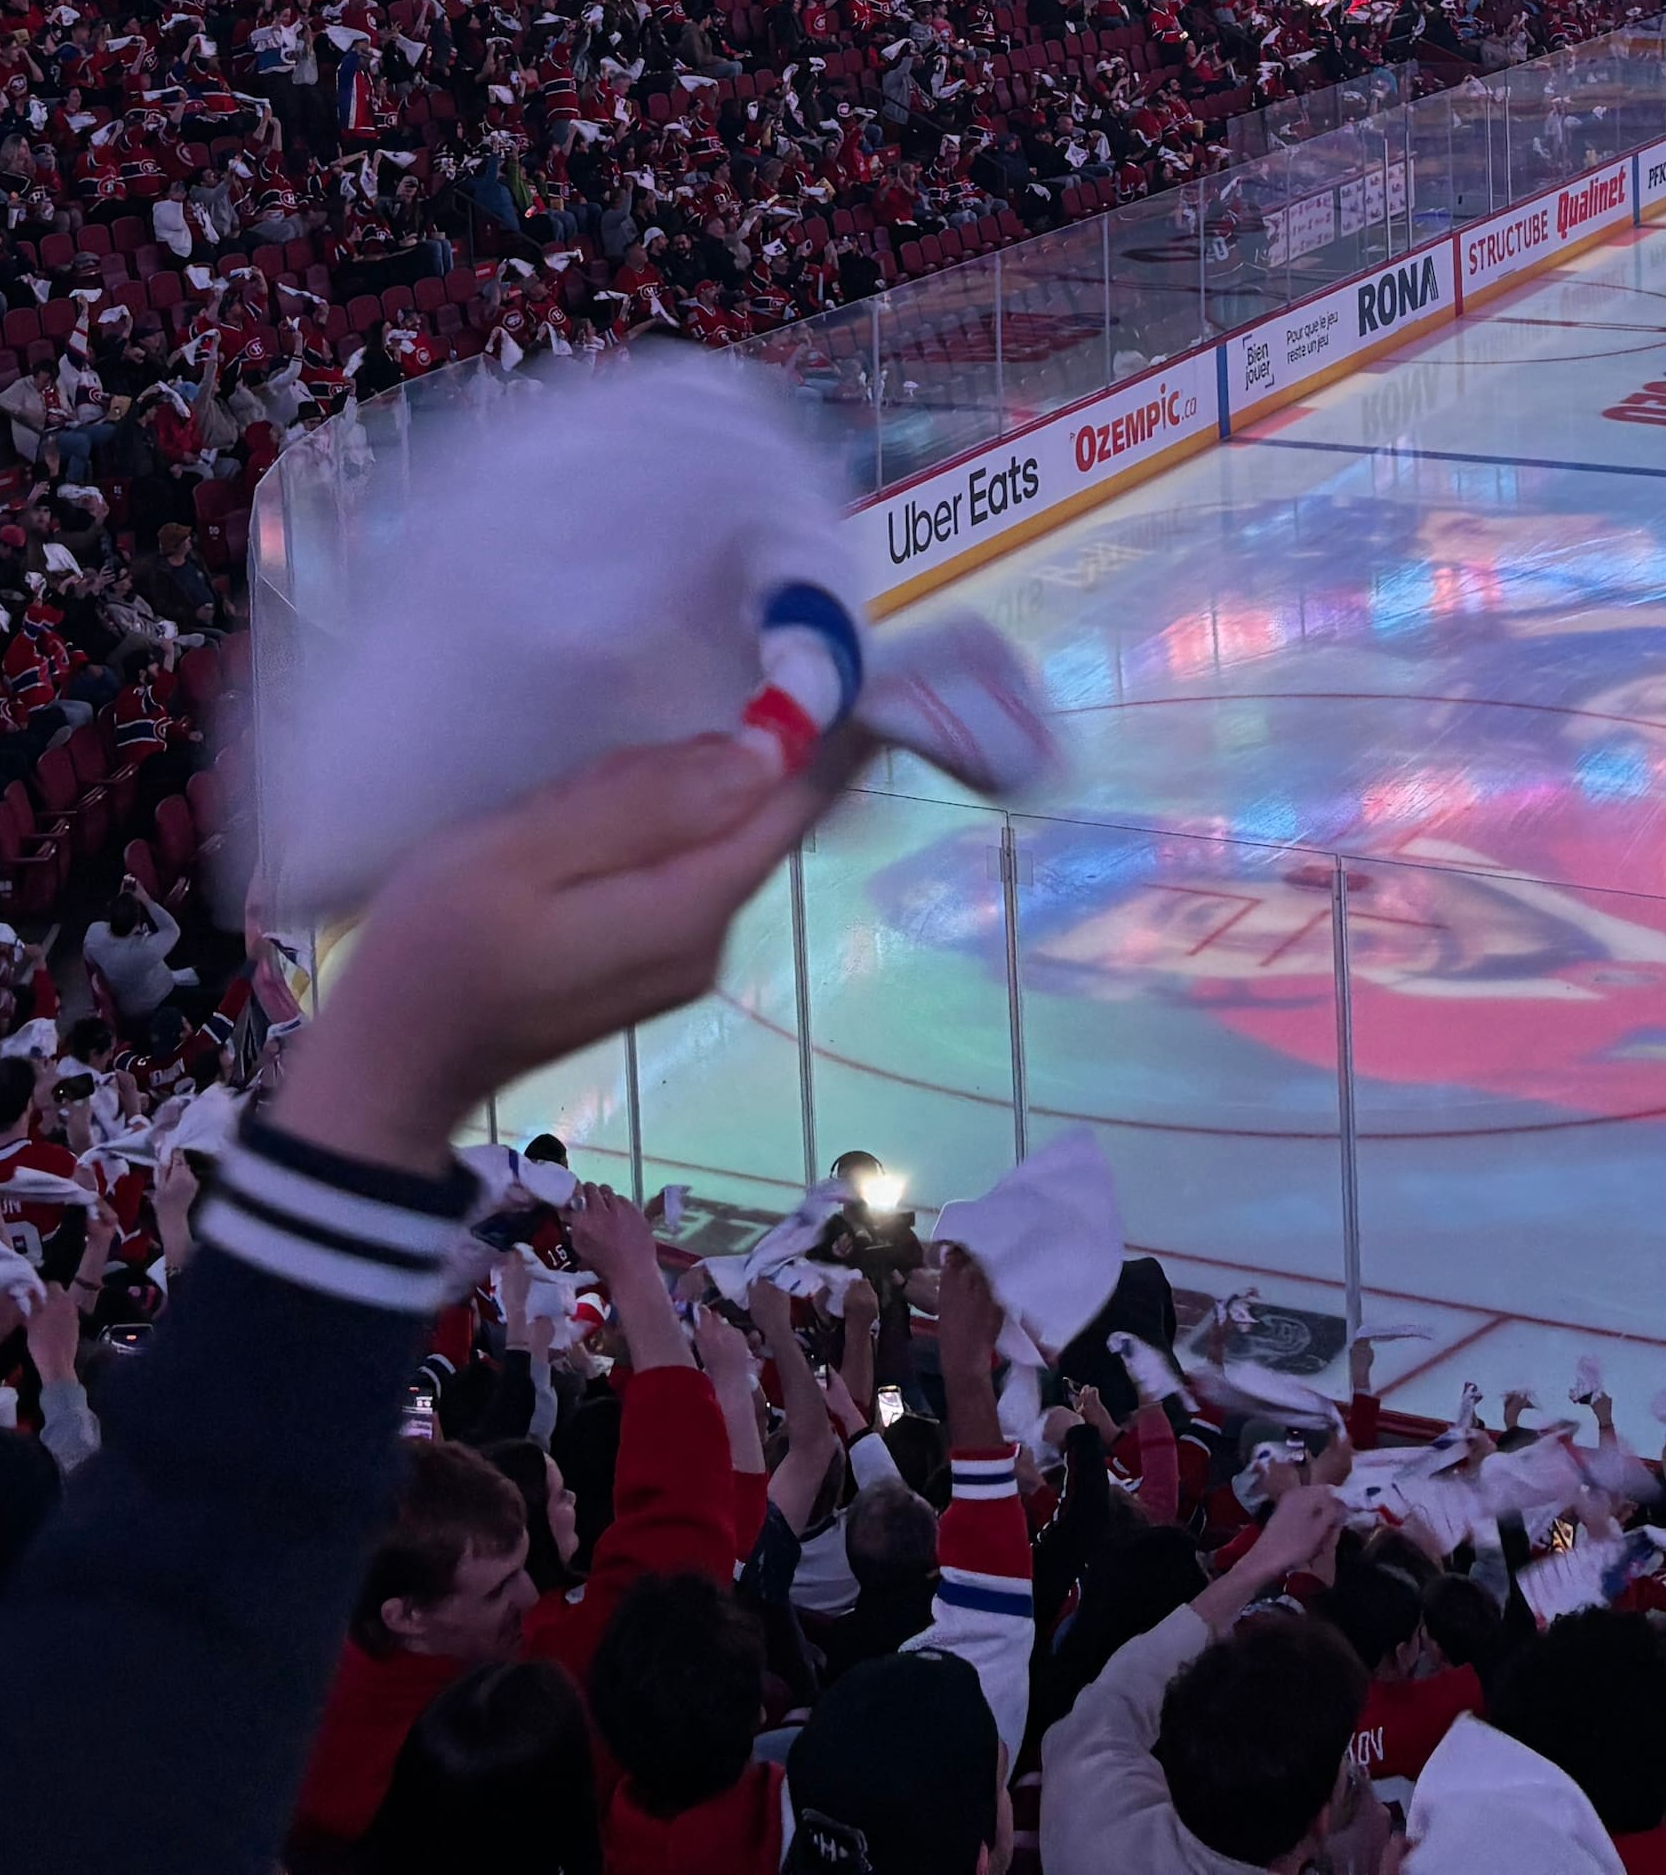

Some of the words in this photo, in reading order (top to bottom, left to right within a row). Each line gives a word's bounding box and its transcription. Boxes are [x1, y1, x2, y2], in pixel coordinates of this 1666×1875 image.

[1557, 165, 1627, 240] Qualinet
[1469, 209, 1548, 275] STRUCTUBE
[1358, 255, 1439, 338] RONA
[1286, 326, 1306, 346] Pour
[1305, 321, 1319, 338] que
[1326, 311, 1339, 330] jeu
[1287, 343, 1306, 364] reste
[1306, 341, 1318, 353] un
[1317, 334, 1329, 353] jeu
[1245, 361, 1270, 391] jouer
[1247, 342, 1269, 366] Bien
[888, 493, 963, 565] Uber
[969, 456, 1040, 526] Eats
